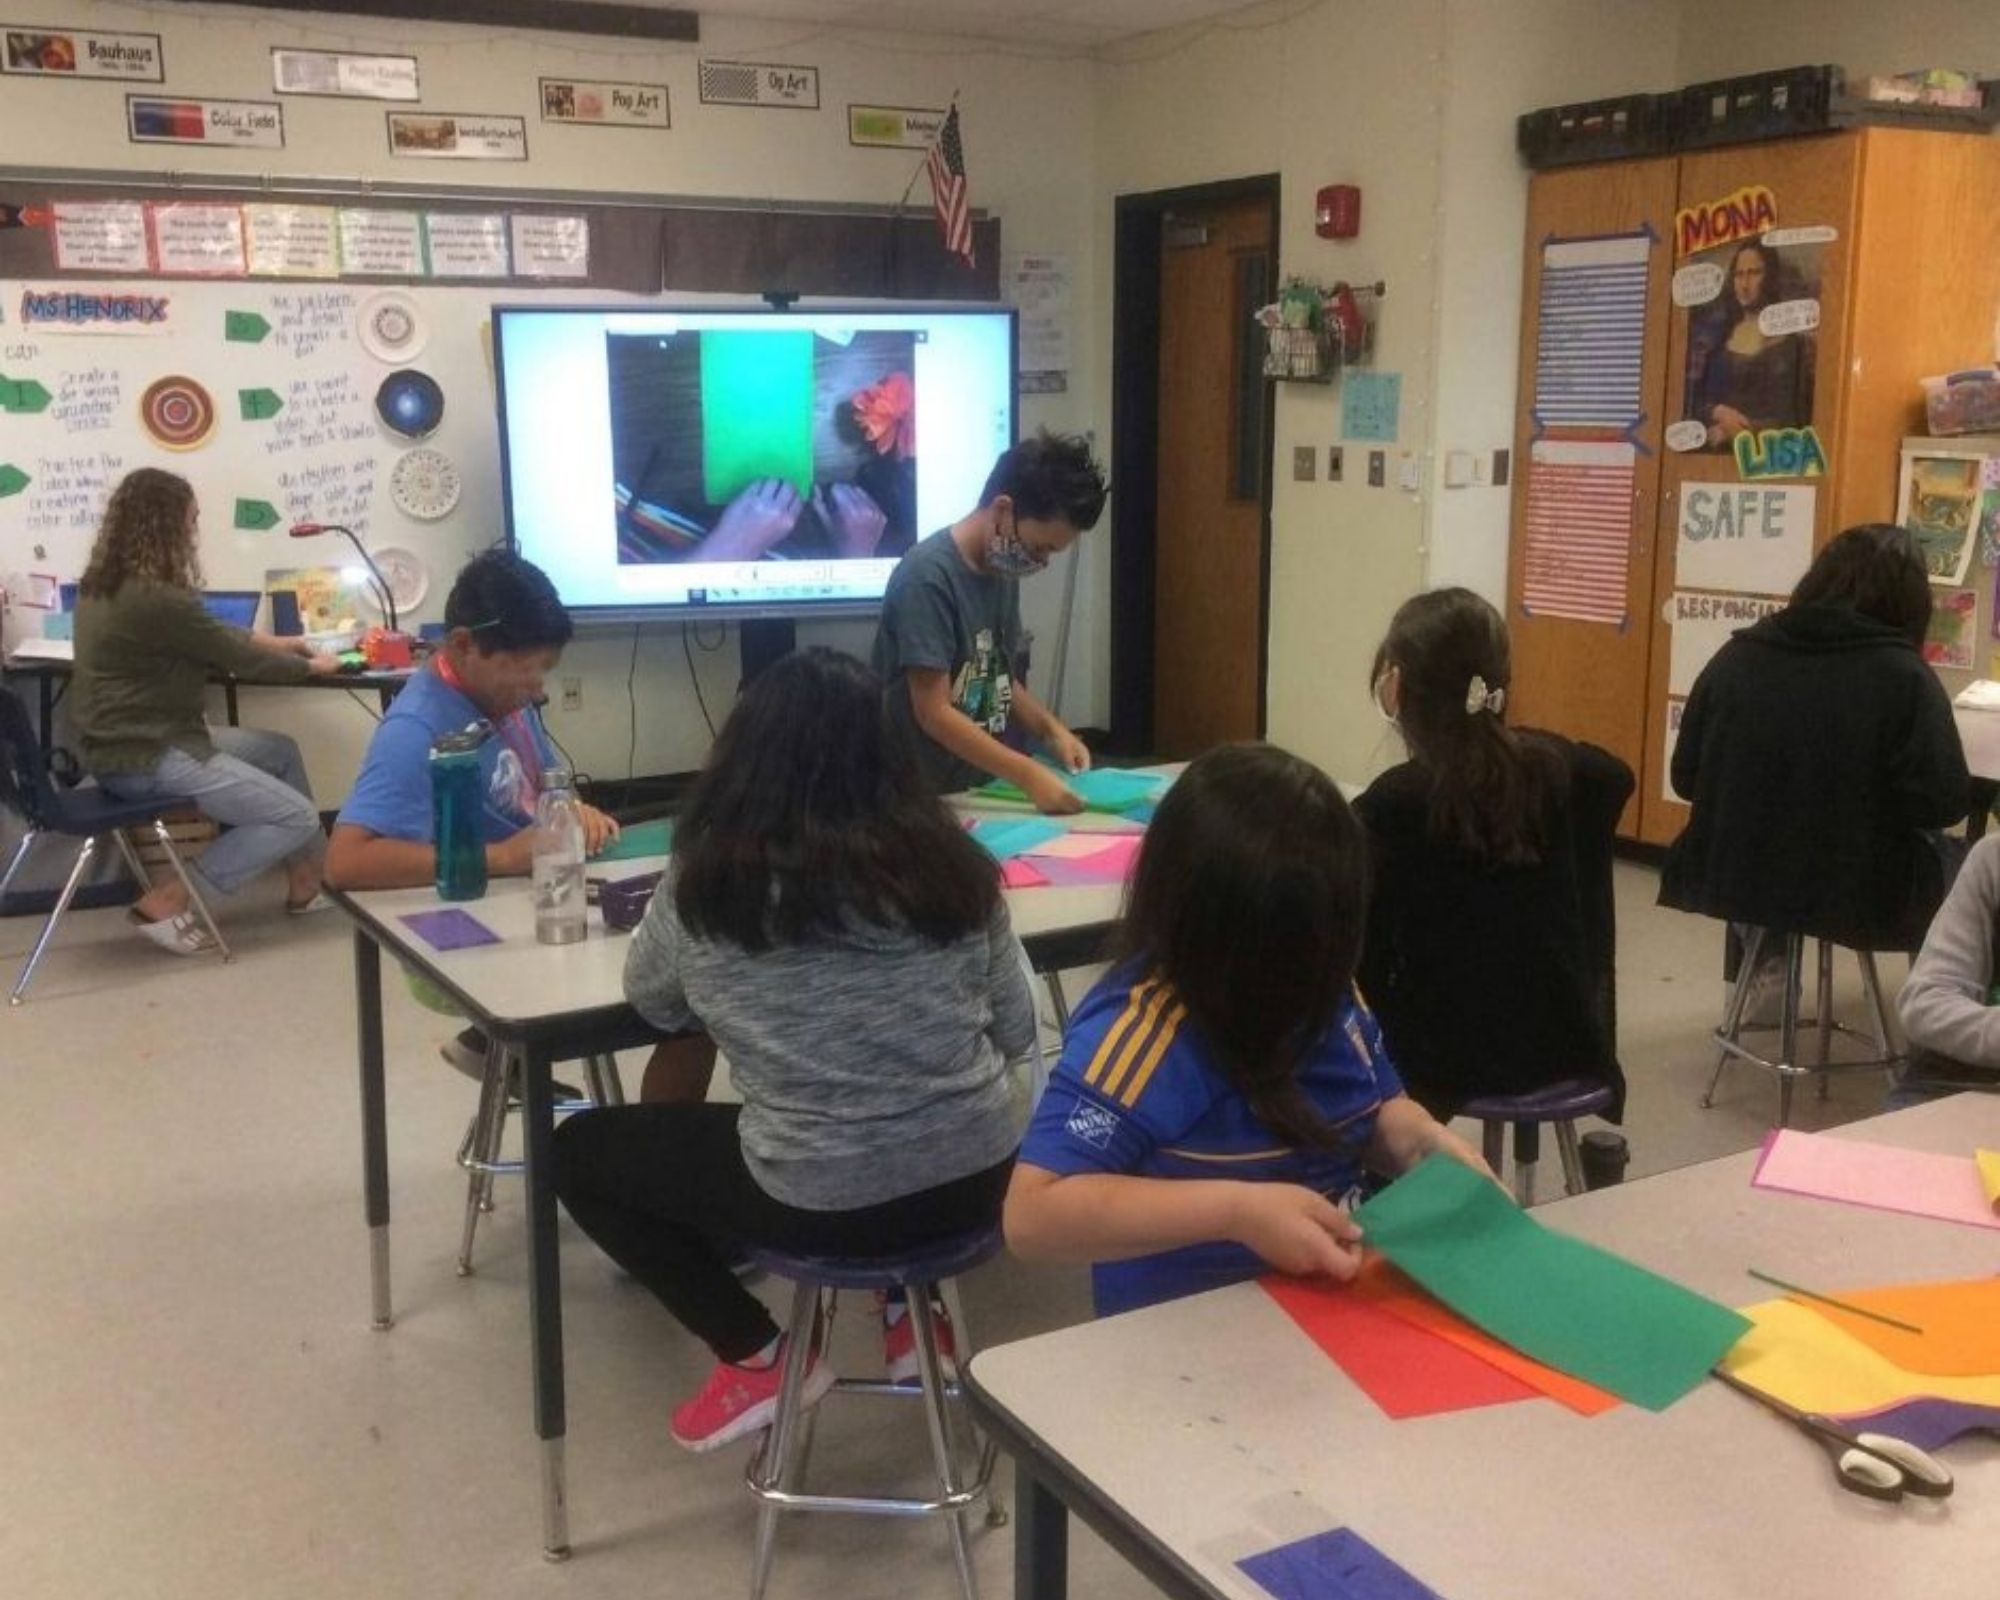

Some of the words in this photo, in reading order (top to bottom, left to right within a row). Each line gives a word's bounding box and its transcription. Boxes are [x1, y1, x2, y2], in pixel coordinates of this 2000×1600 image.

[88, 40, 152, 62] Bauhaus
[768, 71, 784, 91] Op
[787, 73, 808, 91] Art
[612, 89, 633, 110] Pop
[636, 92, 658, 110] Art
[1682, 190, 1775, 257] MONA
[63, 293, 170, 324] HENDRIX
[1738, 427, 1826, 477] LISA
[1684, 489, 1786, 542] SAFE
[1676, 597, 1788, 620] RESPONSIB
